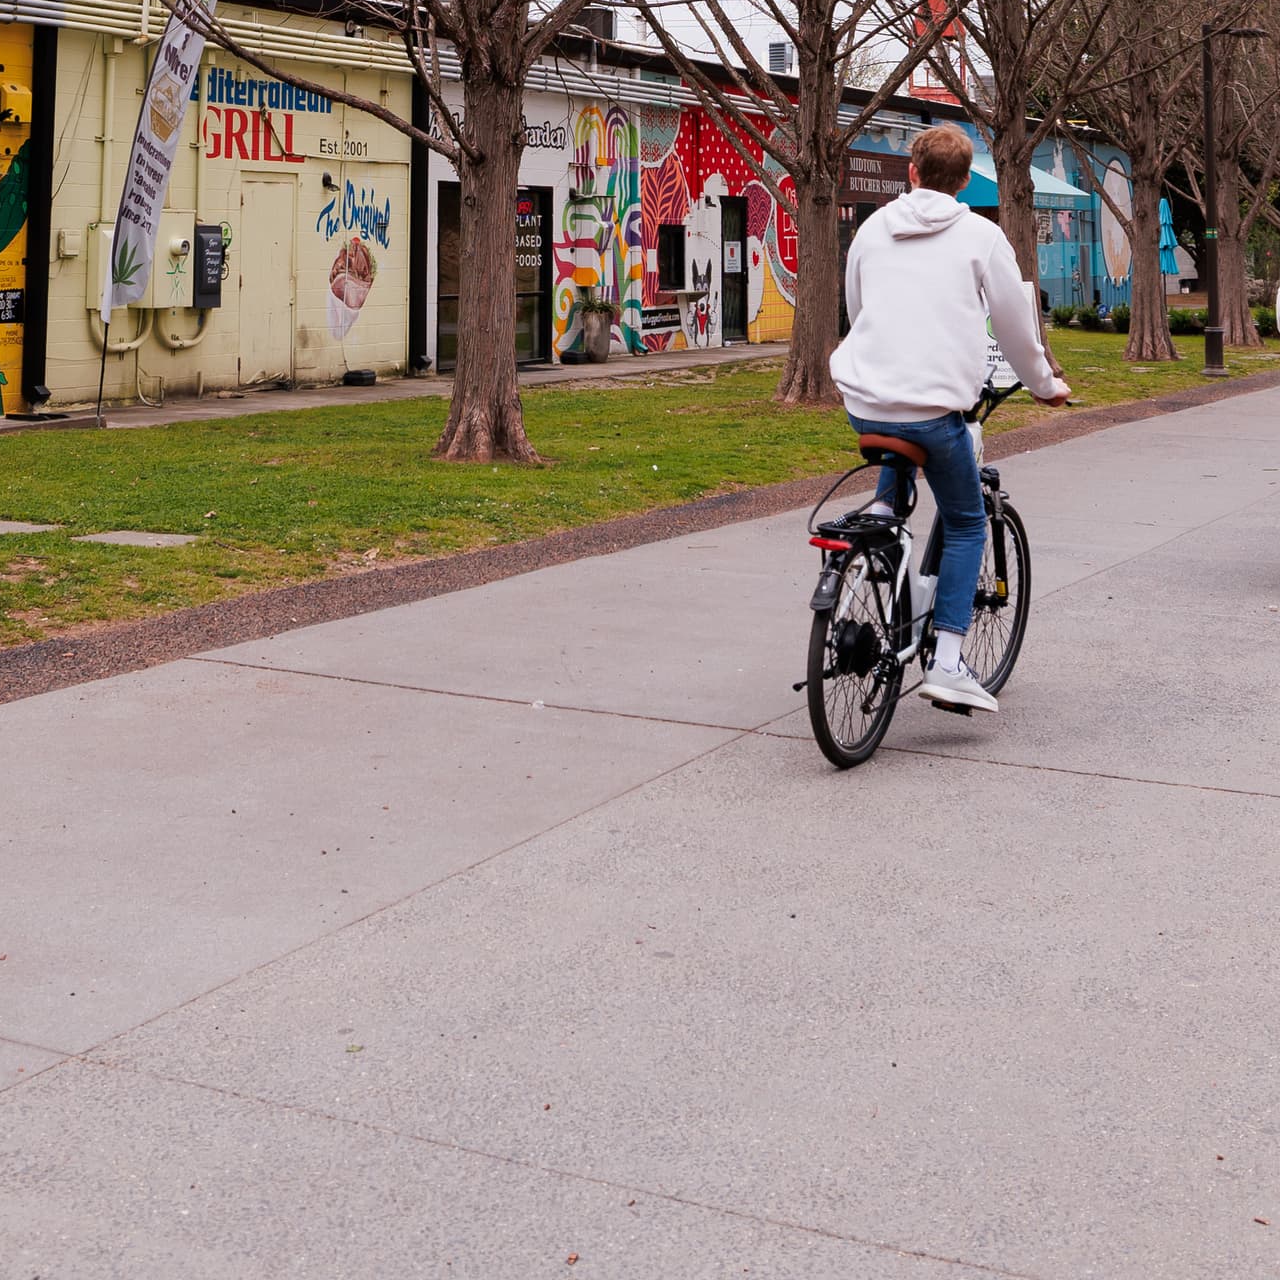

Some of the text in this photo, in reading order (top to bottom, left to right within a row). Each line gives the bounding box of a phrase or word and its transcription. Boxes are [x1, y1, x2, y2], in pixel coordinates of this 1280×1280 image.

[190, 67, 332, 114] editerranean
[203, 105, 305, 163] GRILL
[319, 138, 369, 157] Est. 2001
[849, 157, 882, 174] MIDTOWN
[849, 176, 906, 195] BUTCHER SHOPPE
